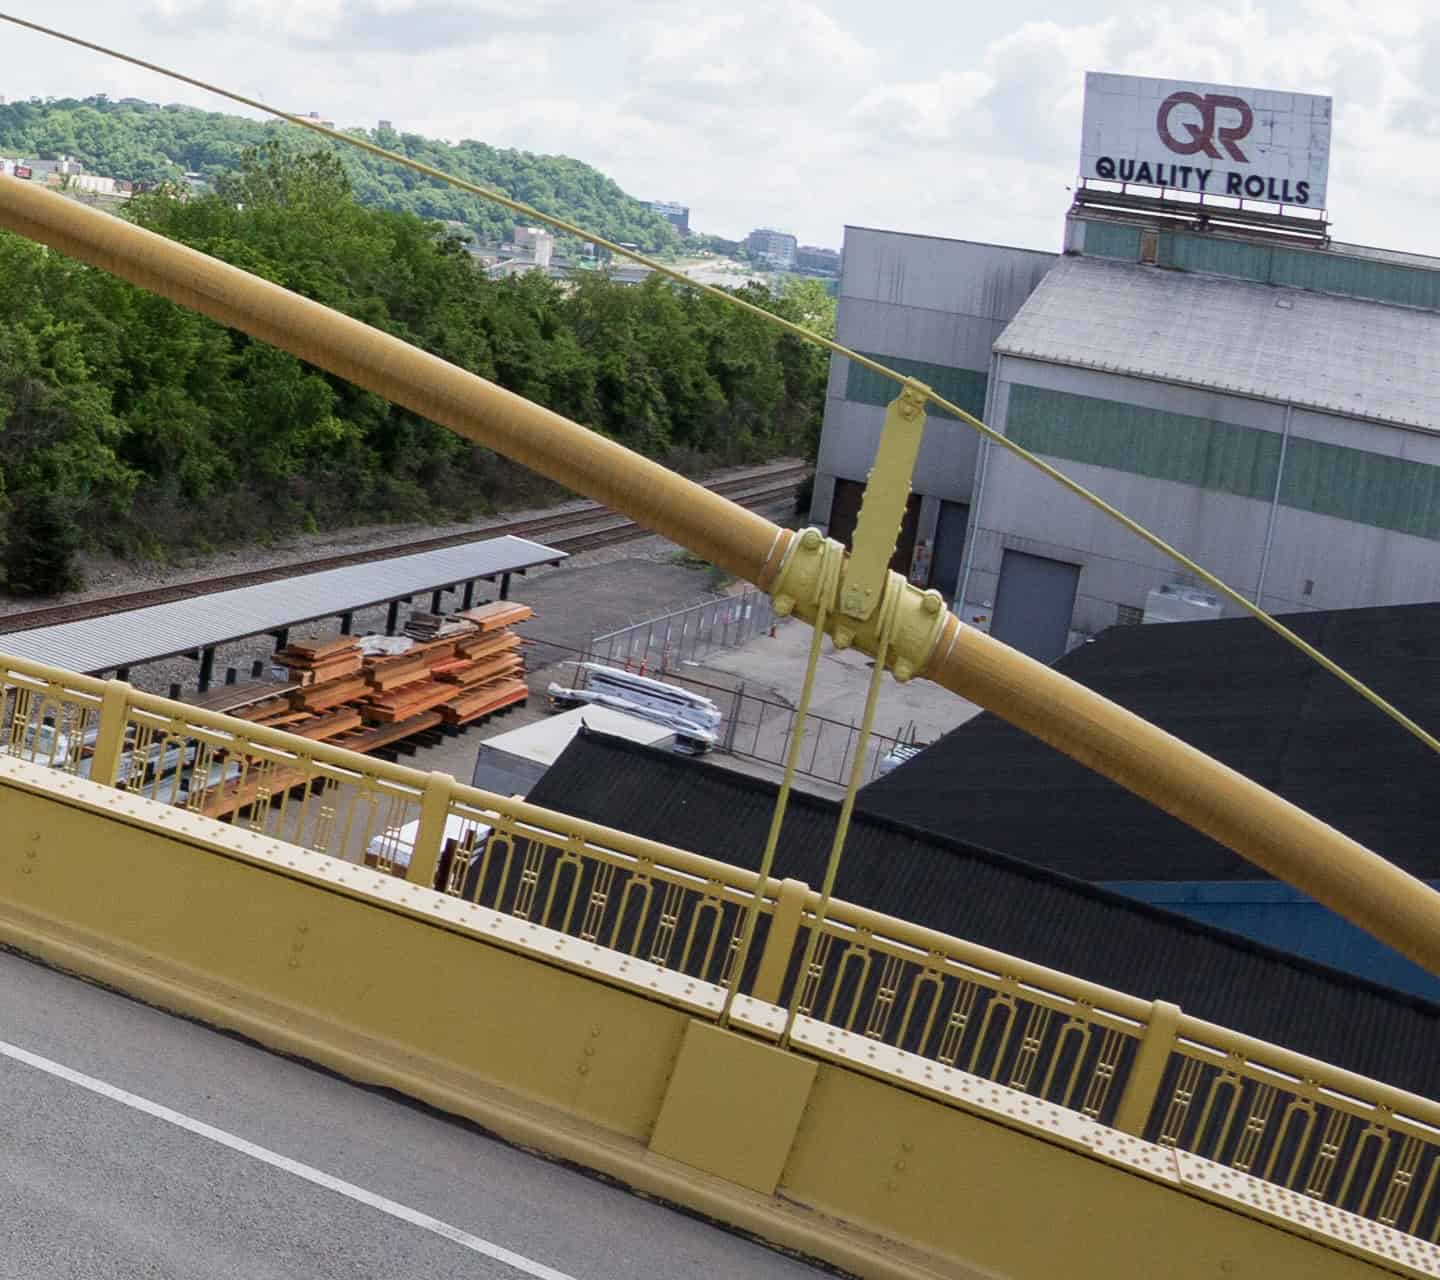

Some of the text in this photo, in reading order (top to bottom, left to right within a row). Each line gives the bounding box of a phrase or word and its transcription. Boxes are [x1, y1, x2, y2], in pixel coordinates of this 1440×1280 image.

[1156, 91, 1254, 163] QR
[1095, 156, 1310, 205] QUALITY ROLLS
